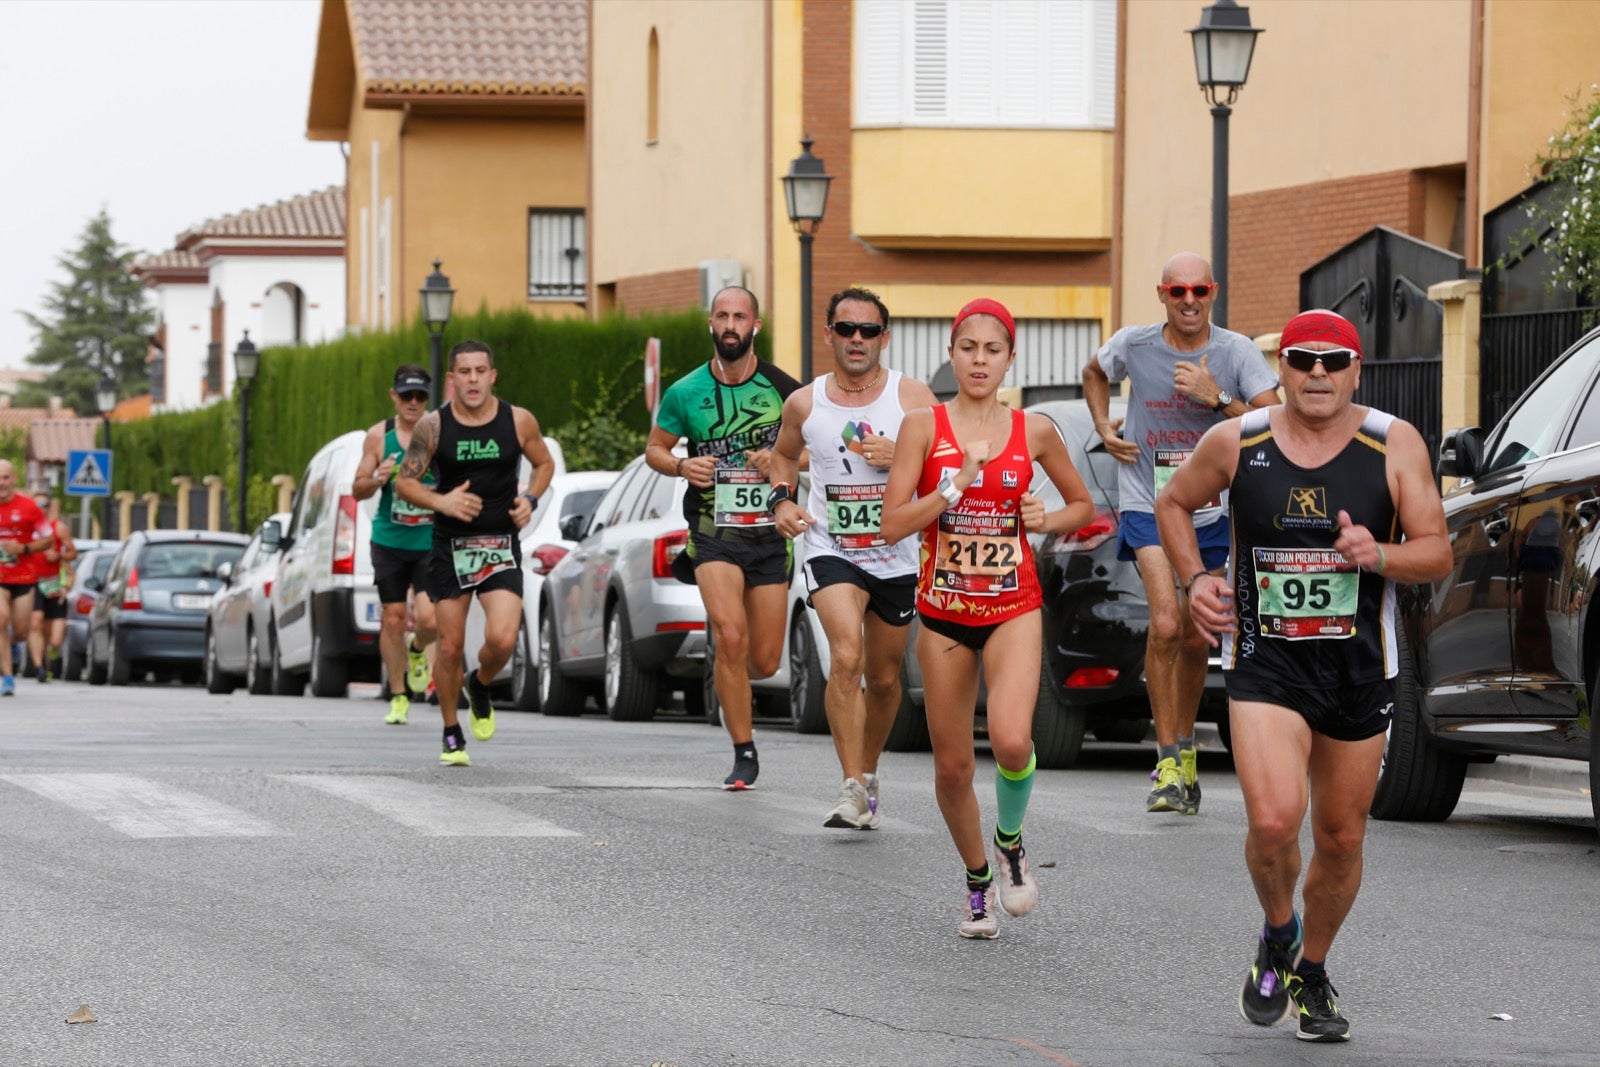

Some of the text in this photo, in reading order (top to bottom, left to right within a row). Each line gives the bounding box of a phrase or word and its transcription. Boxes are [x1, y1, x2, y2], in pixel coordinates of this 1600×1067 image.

[457, 438, 500, 454] FILA
[735, 487, 762, 508] 56
[963, 498, 996, 507] Clínicas
[838, 503, 882, 528] 943
[956, 516, 972, 526] GRAN
[972, 516, 992, 527] PREMIO
[1281, 517, 1312, 525] GRANADA
[948, 540, 1017, 567] 2122
[1276, 552, 1294, 564] GRAN
[1295, 552, 1320, 564] PREMIO
[1322, 552, 1331, 564] DE
[1283, 578, 1331, 610] 95
